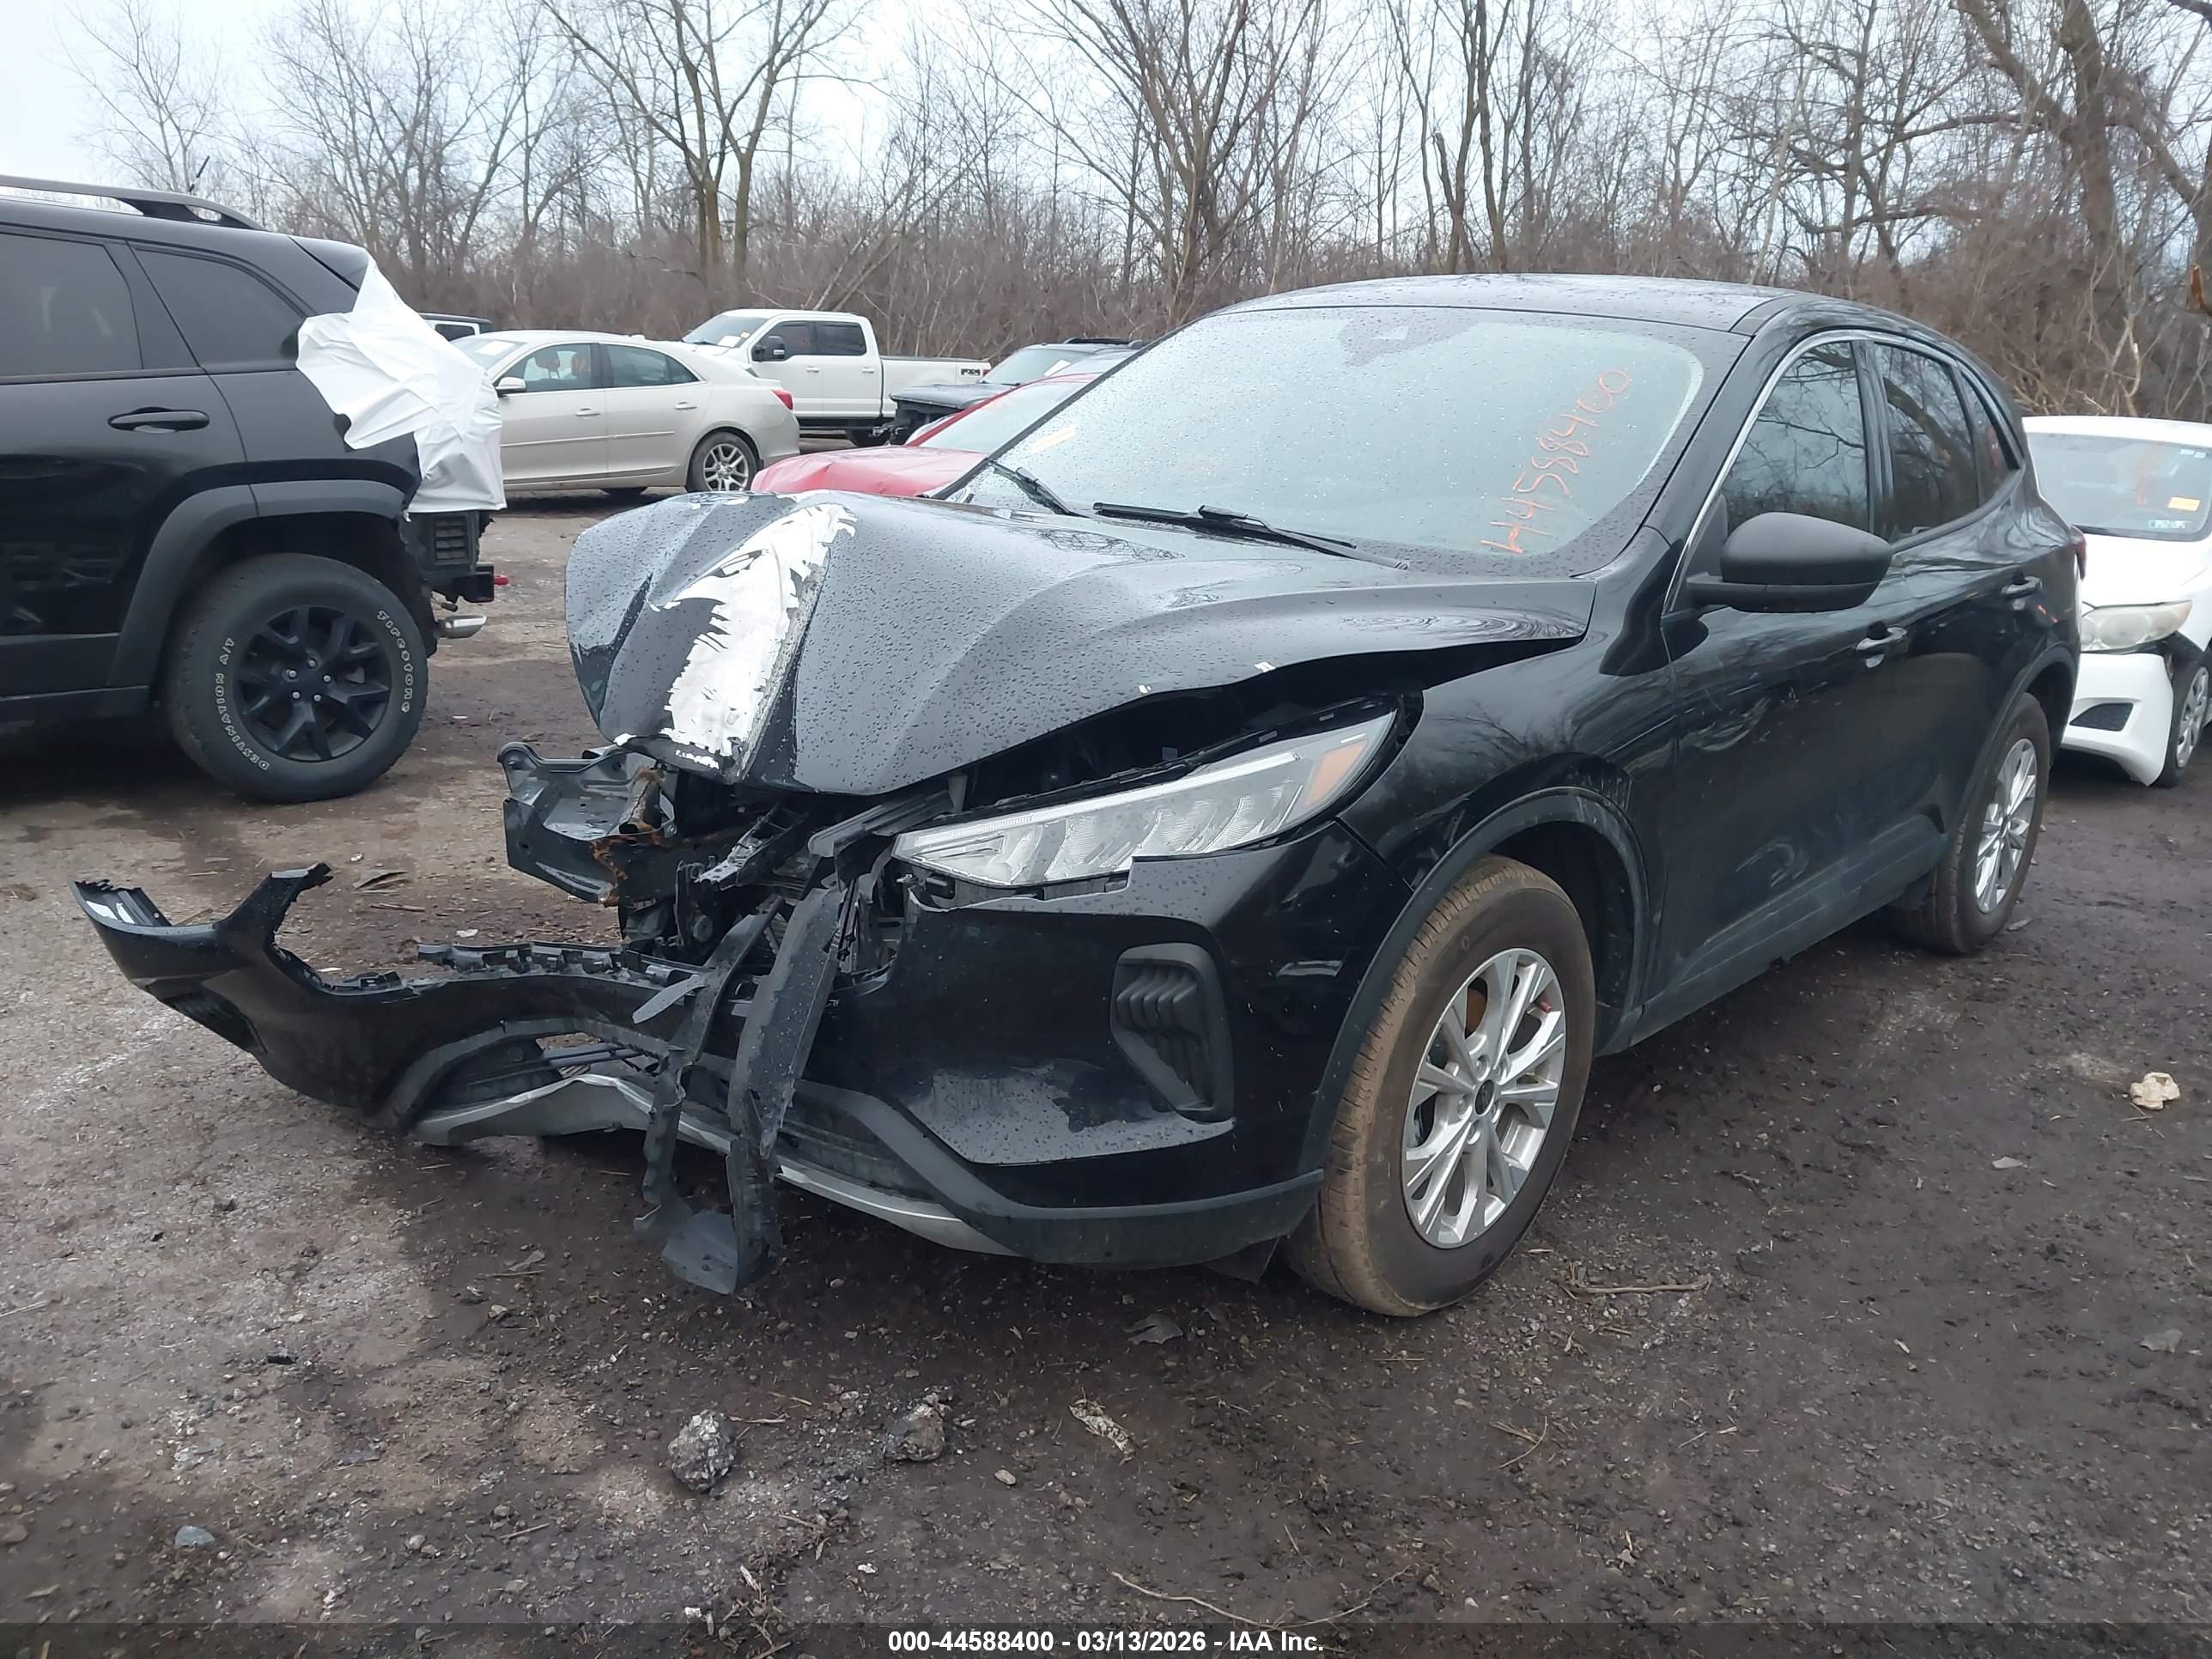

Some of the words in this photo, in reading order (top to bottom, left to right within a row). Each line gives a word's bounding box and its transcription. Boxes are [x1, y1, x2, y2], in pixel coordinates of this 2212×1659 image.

[1480, 370, 1630, 555] 44588400
[219, 637, 234, 665] A/T
[215, 672, 270, 770] DESTINATION
